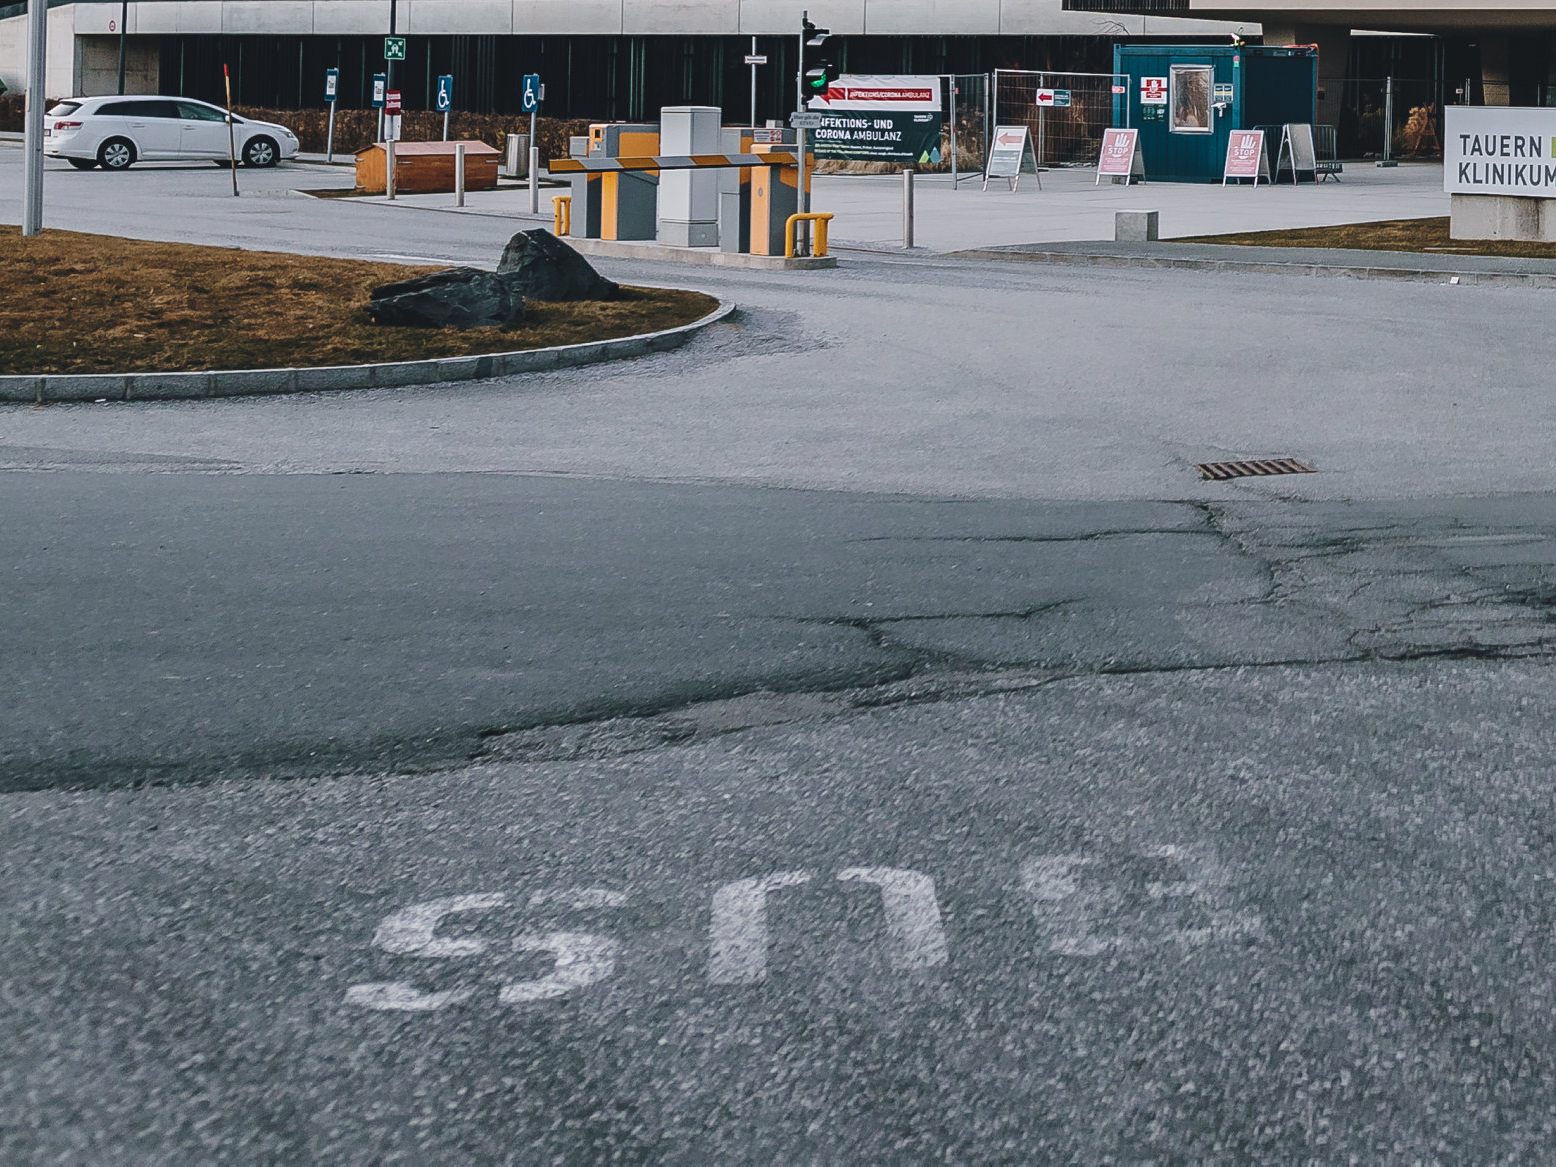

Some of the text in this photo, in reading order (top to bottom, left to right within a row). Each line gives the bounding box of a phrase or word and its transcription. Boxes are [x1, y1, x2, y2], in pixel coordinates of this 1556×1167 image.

[874, 119, 893, 130] UND
[815, 129, 902, 142] CORONA AMBULANZ
[1107, 146, 1129, 155] STOP
[1459, 134, 1542, 158] TAUERN
[1233, 149, 1256, 157] STOP
